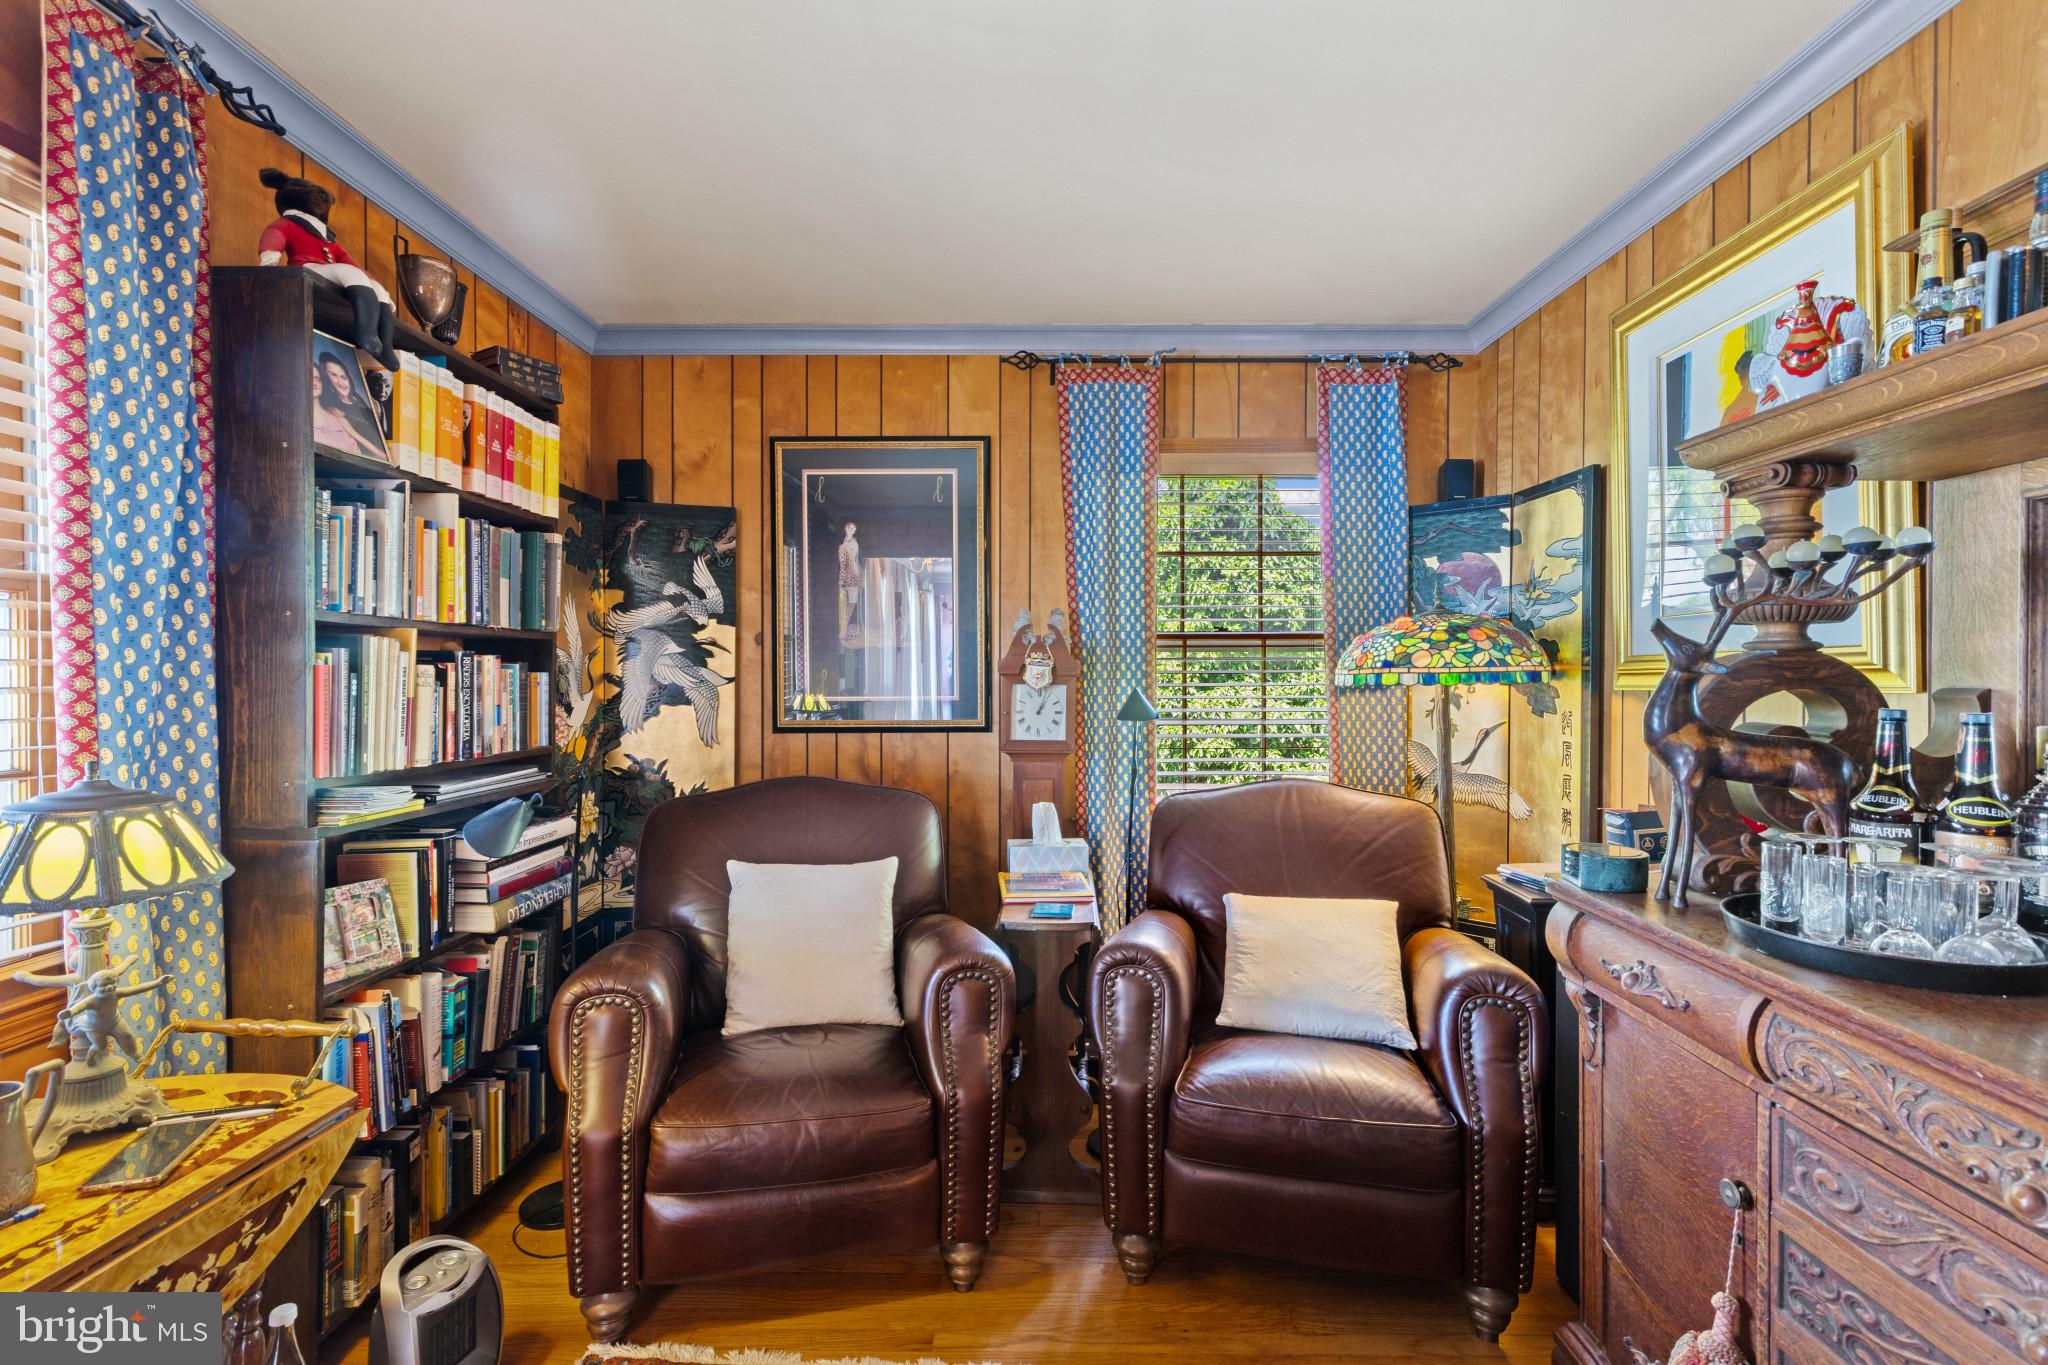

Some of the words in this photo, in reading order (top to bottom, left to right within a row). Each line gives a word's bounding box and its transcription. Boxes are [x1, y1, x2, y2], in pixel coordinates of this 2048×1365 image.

[1860, 794, 1908, 807] HEUBLEIN
[1953, 804, 2010, 819] HEUBLEIN
[1850, 822, 1913, 838] MARGARITA
[507, 881, 571, 923] MICHELANGELO
